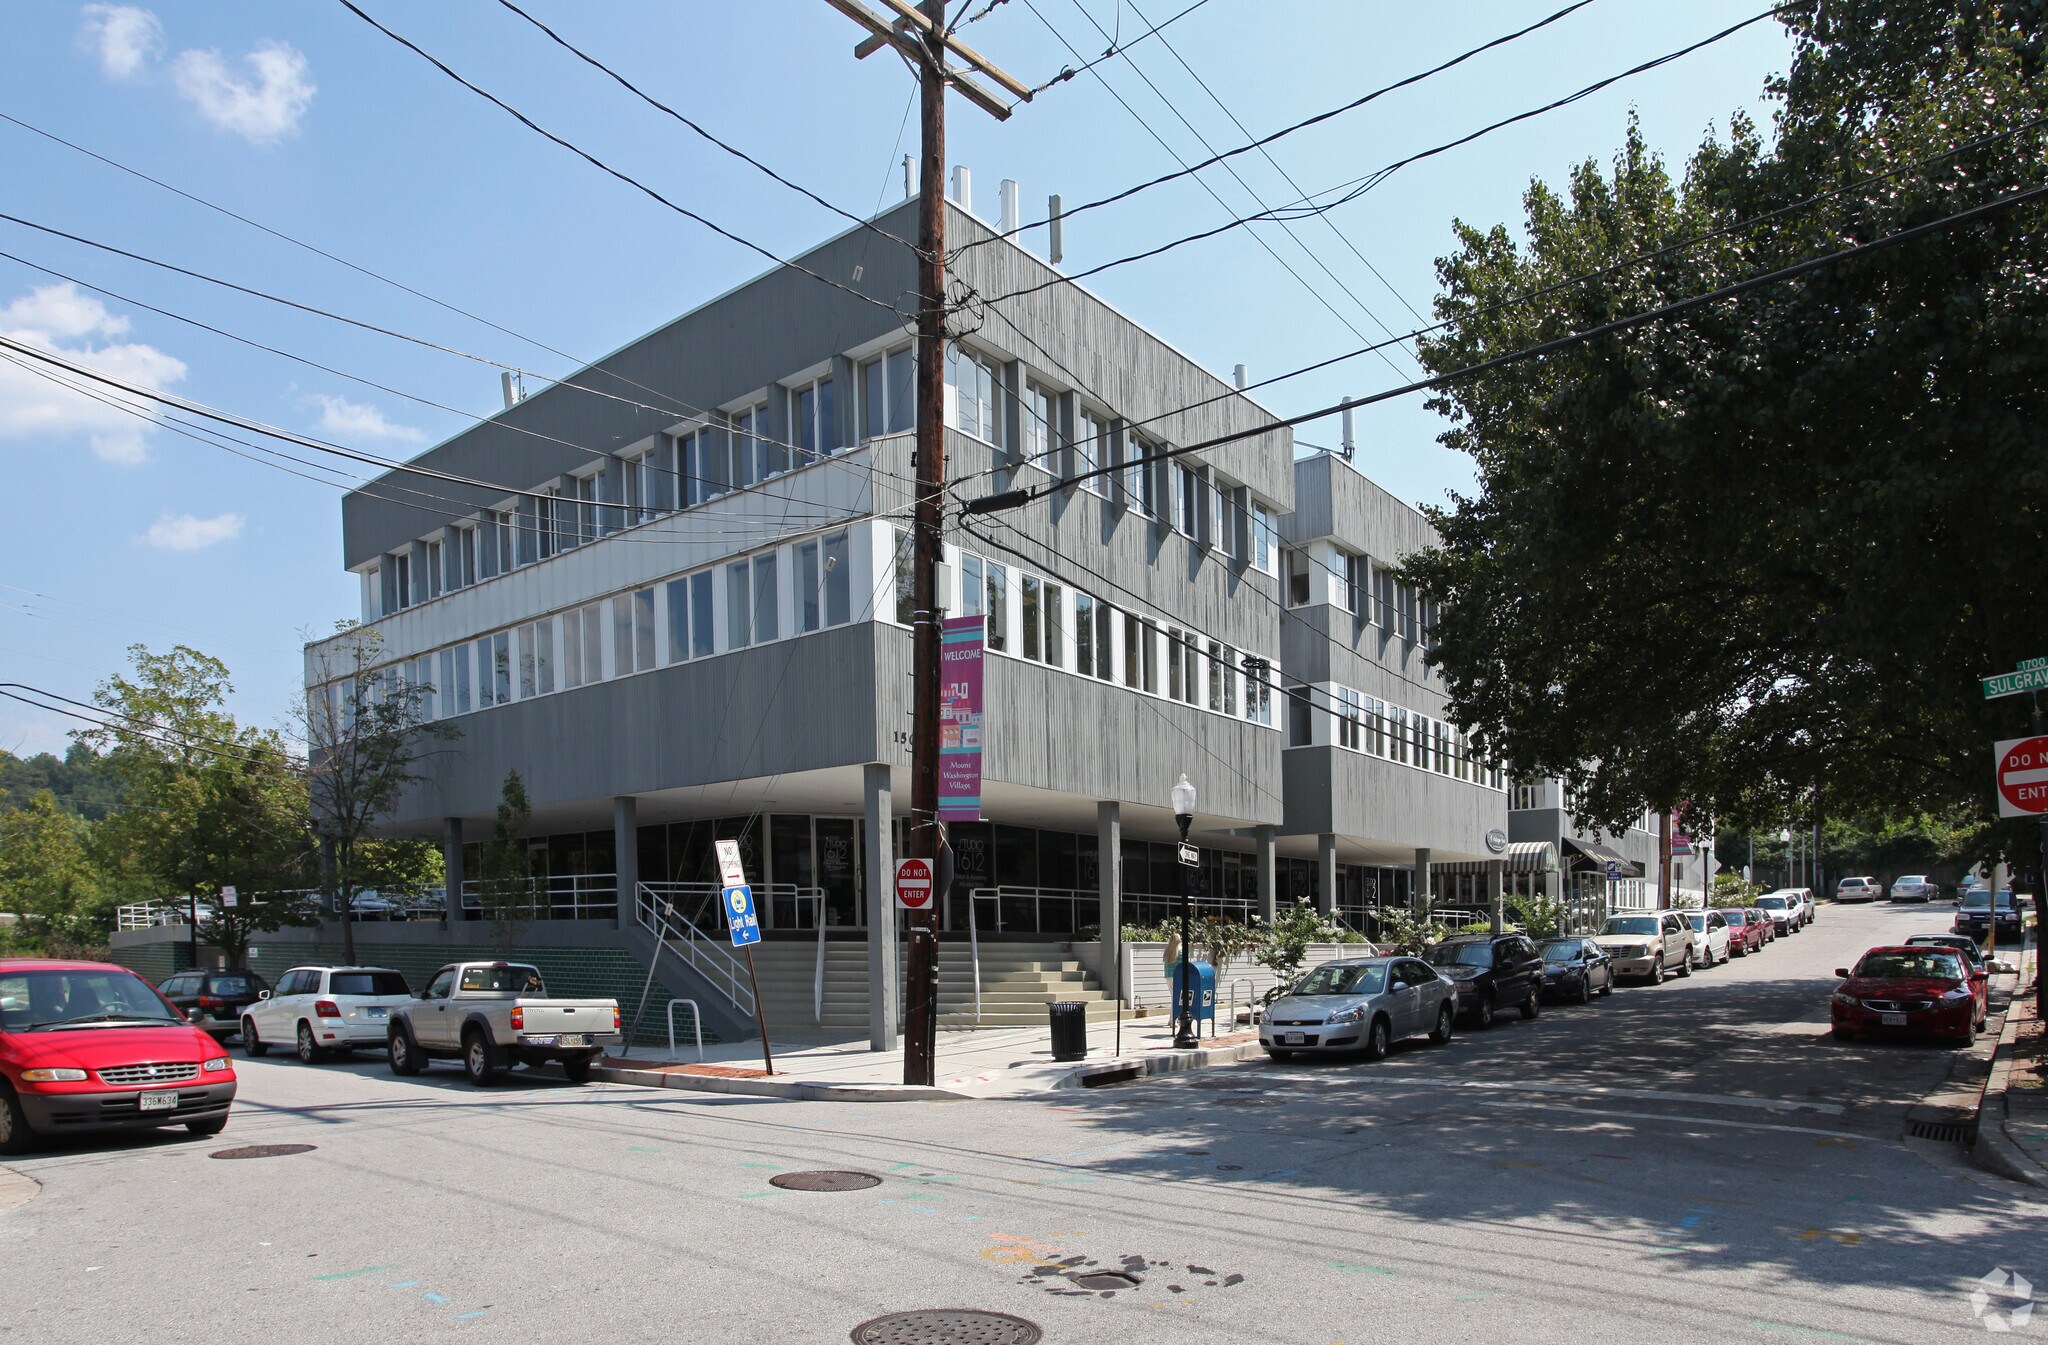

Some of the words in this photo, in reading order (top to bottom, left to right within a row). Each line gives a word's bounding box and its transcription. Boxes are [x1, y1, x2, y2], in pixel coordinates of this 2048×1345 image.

[944, 649, 981, 662] WELCOME
[2022, 657, 2046, 670] 1700
[950, 761, 971, 769] Mount
[2010, 754, 2031, 768] DO
[943, 771, 979, 780] Washington
[949, 781, 971, 790] Village
[724, 846, 732, 856] NO
[957, 851, 985, 872] 1612
[901, 869, 911, 877] DO
[913, 869, 927, 877] NOT
[903, 890, 925, 898] ENTER
[729, 915, 744, 932] Light
[744, 913, 757, 927] Rail
